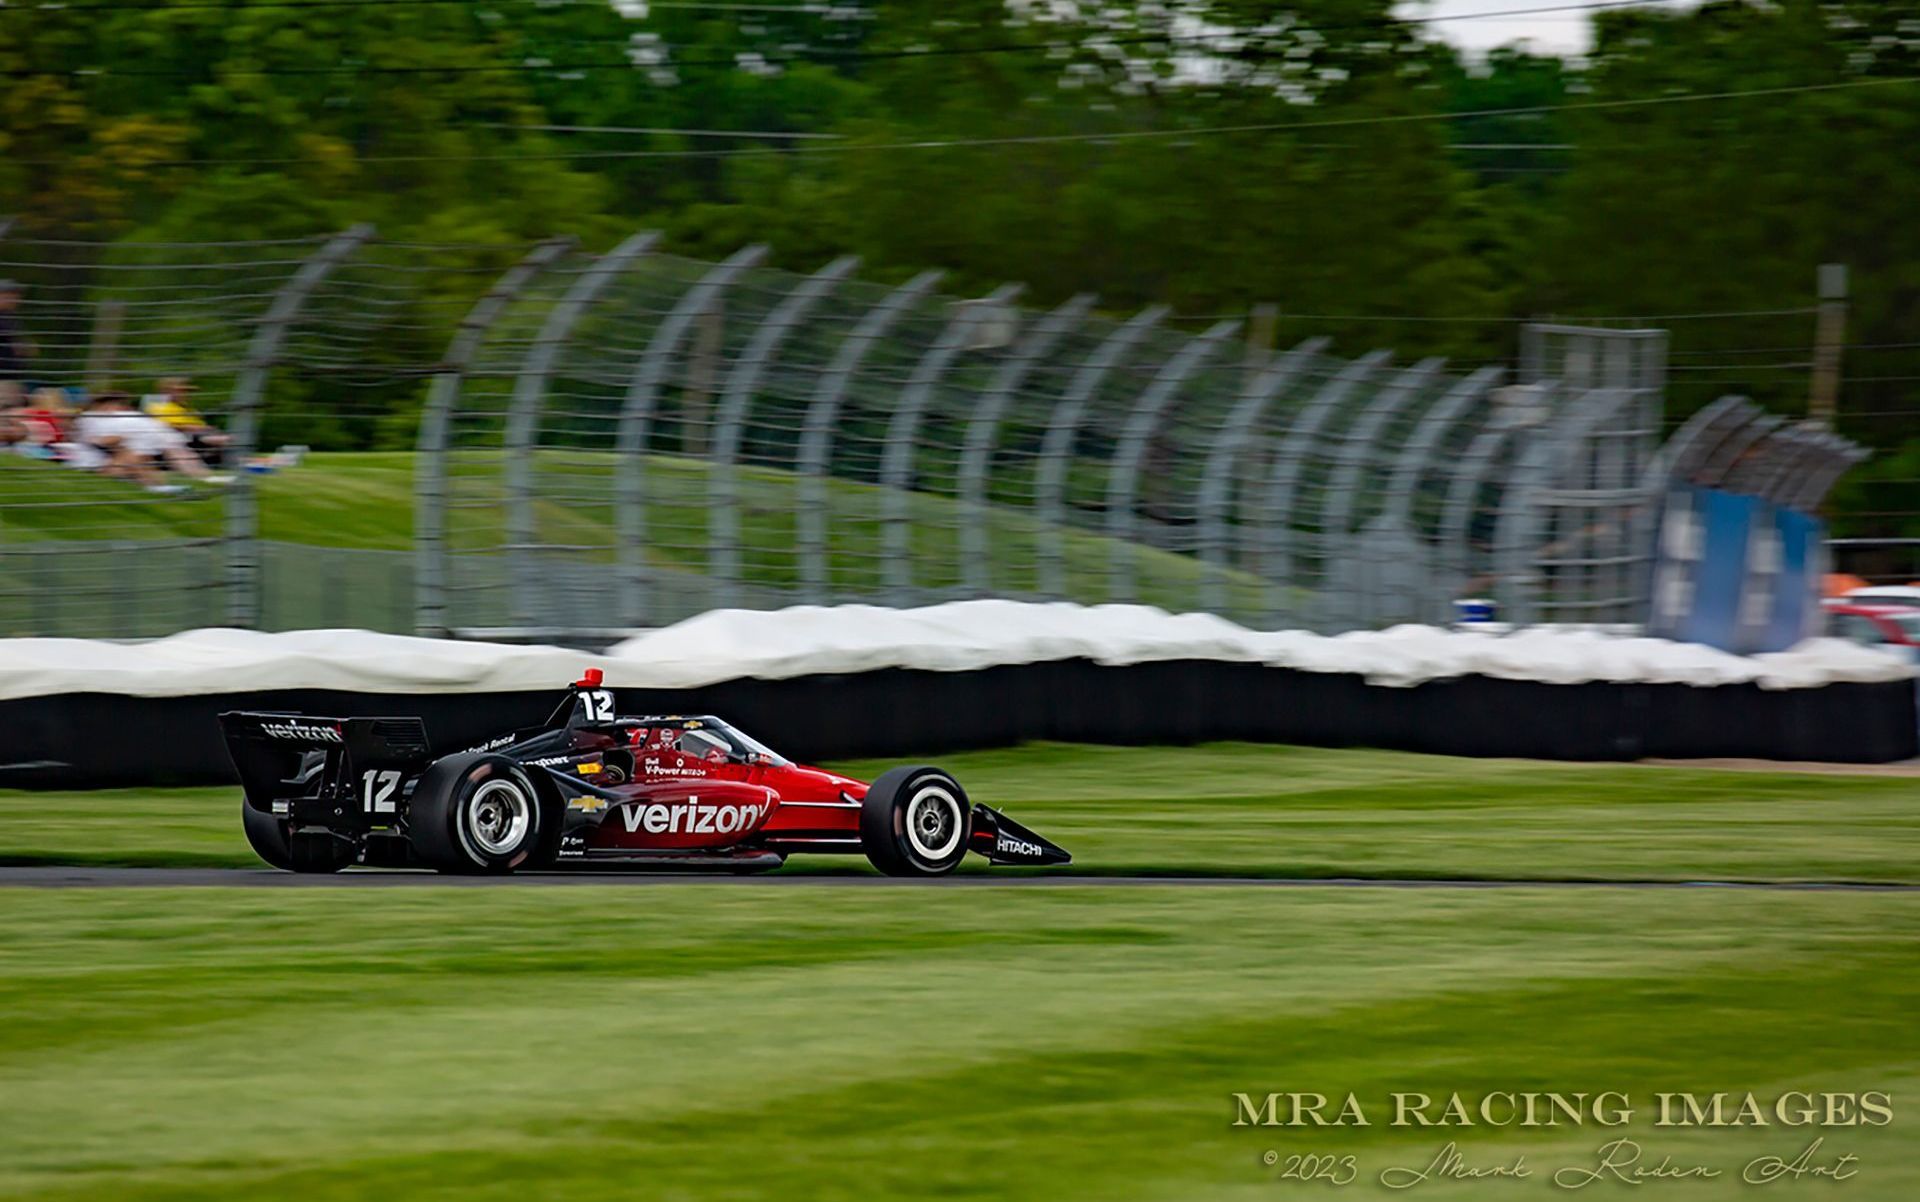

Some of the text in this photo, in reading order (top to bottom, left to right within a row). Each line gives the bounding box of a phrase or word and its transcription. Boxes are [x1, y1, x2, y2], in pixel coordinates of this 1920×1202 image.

[578, 690, 614, 721] 12
[261, 719, 344, 742] verizon
[645, 765, 680, 776] V-Power
[362, 769, 402, 813] 12
[621, 795, 759, 834] verizon
[997, 839, 1042, 856] HITACHI
